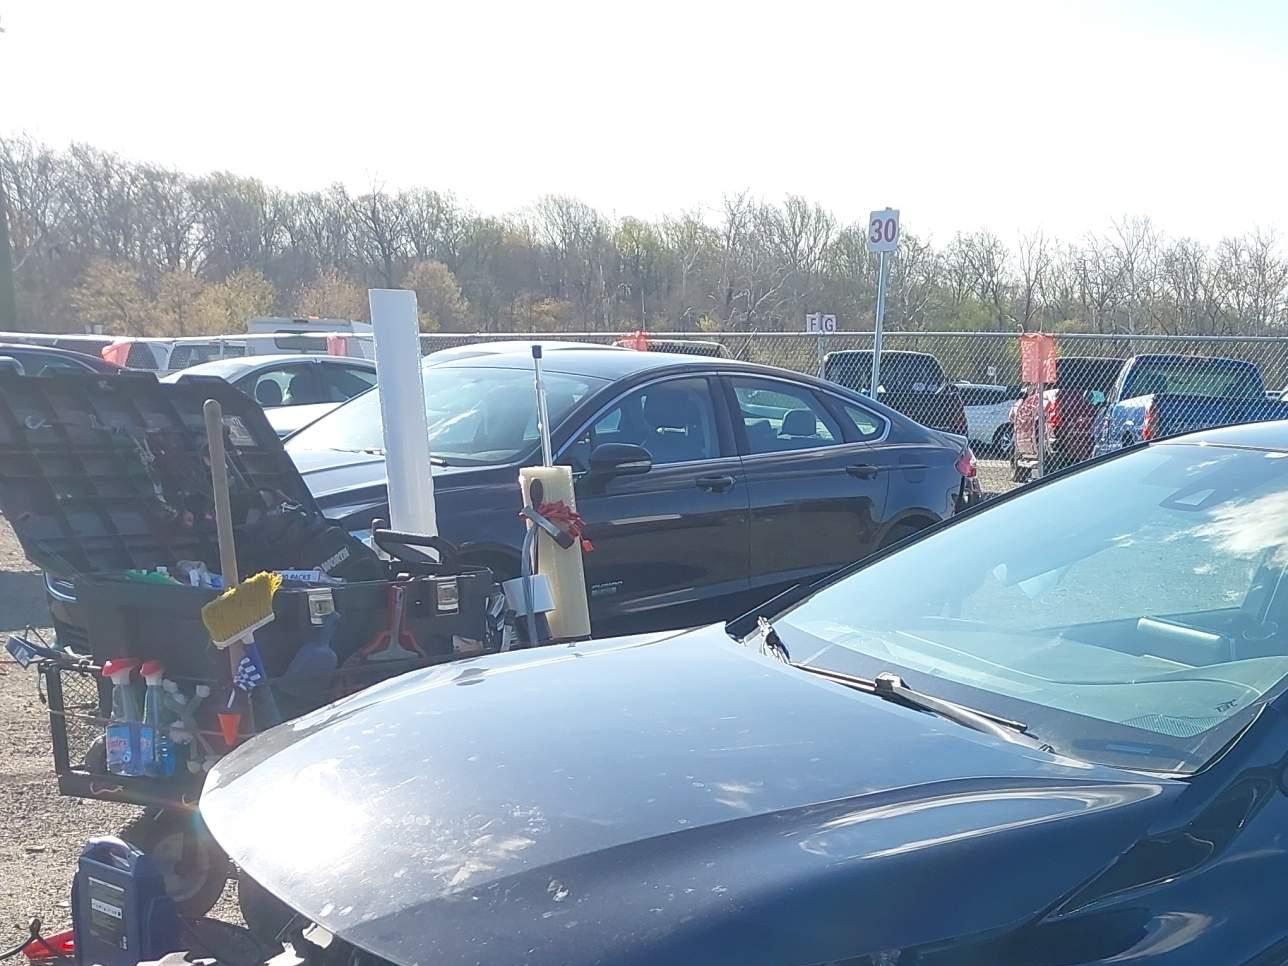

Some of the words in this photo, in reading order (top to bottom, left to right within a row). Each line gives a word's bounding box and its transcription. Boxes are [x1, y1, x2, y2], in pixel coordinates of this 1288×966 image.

[871, 218, 896, 243] 30
[811, 318, 817, 332] F
[825, 318, 833, 332] G
